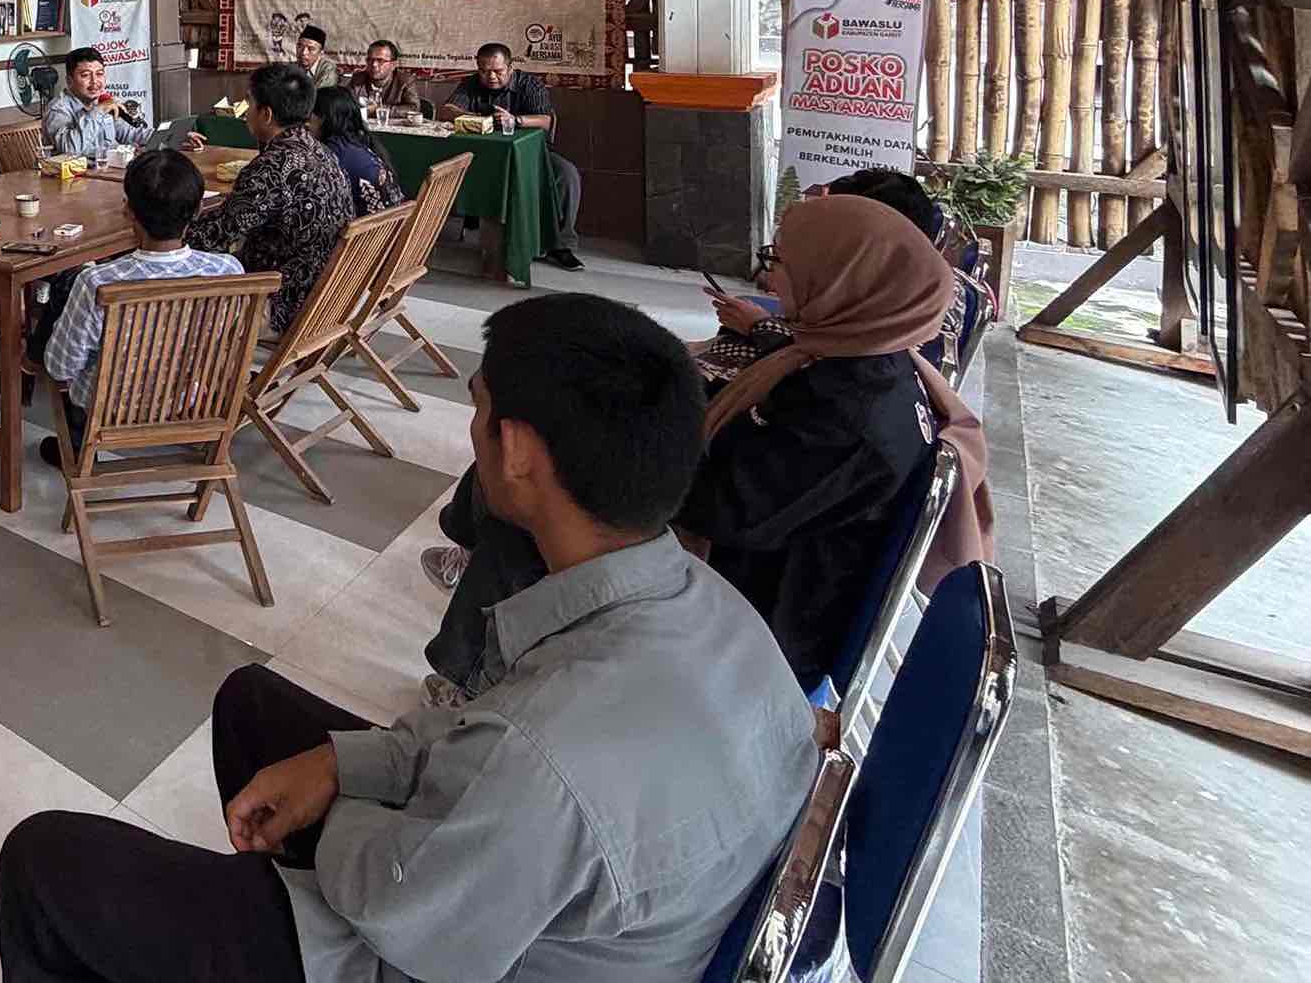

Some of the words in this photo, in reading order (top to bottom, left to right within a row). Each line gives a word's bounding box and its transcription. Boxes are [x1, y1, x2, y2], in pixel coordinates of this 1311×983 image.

[842, 19, 902, 30] BAWASLU
[803, 50, 904, 79] POSKO
[805, 74, 903, 101] ADUAN
[791, 94, 914, 121] MASYARAKAT
[786, 126, 881, 147] PEMUTAKHIRAN
[883, 138, 914, 152] DATA
[824, 143, 874, 159] PEMILIH
